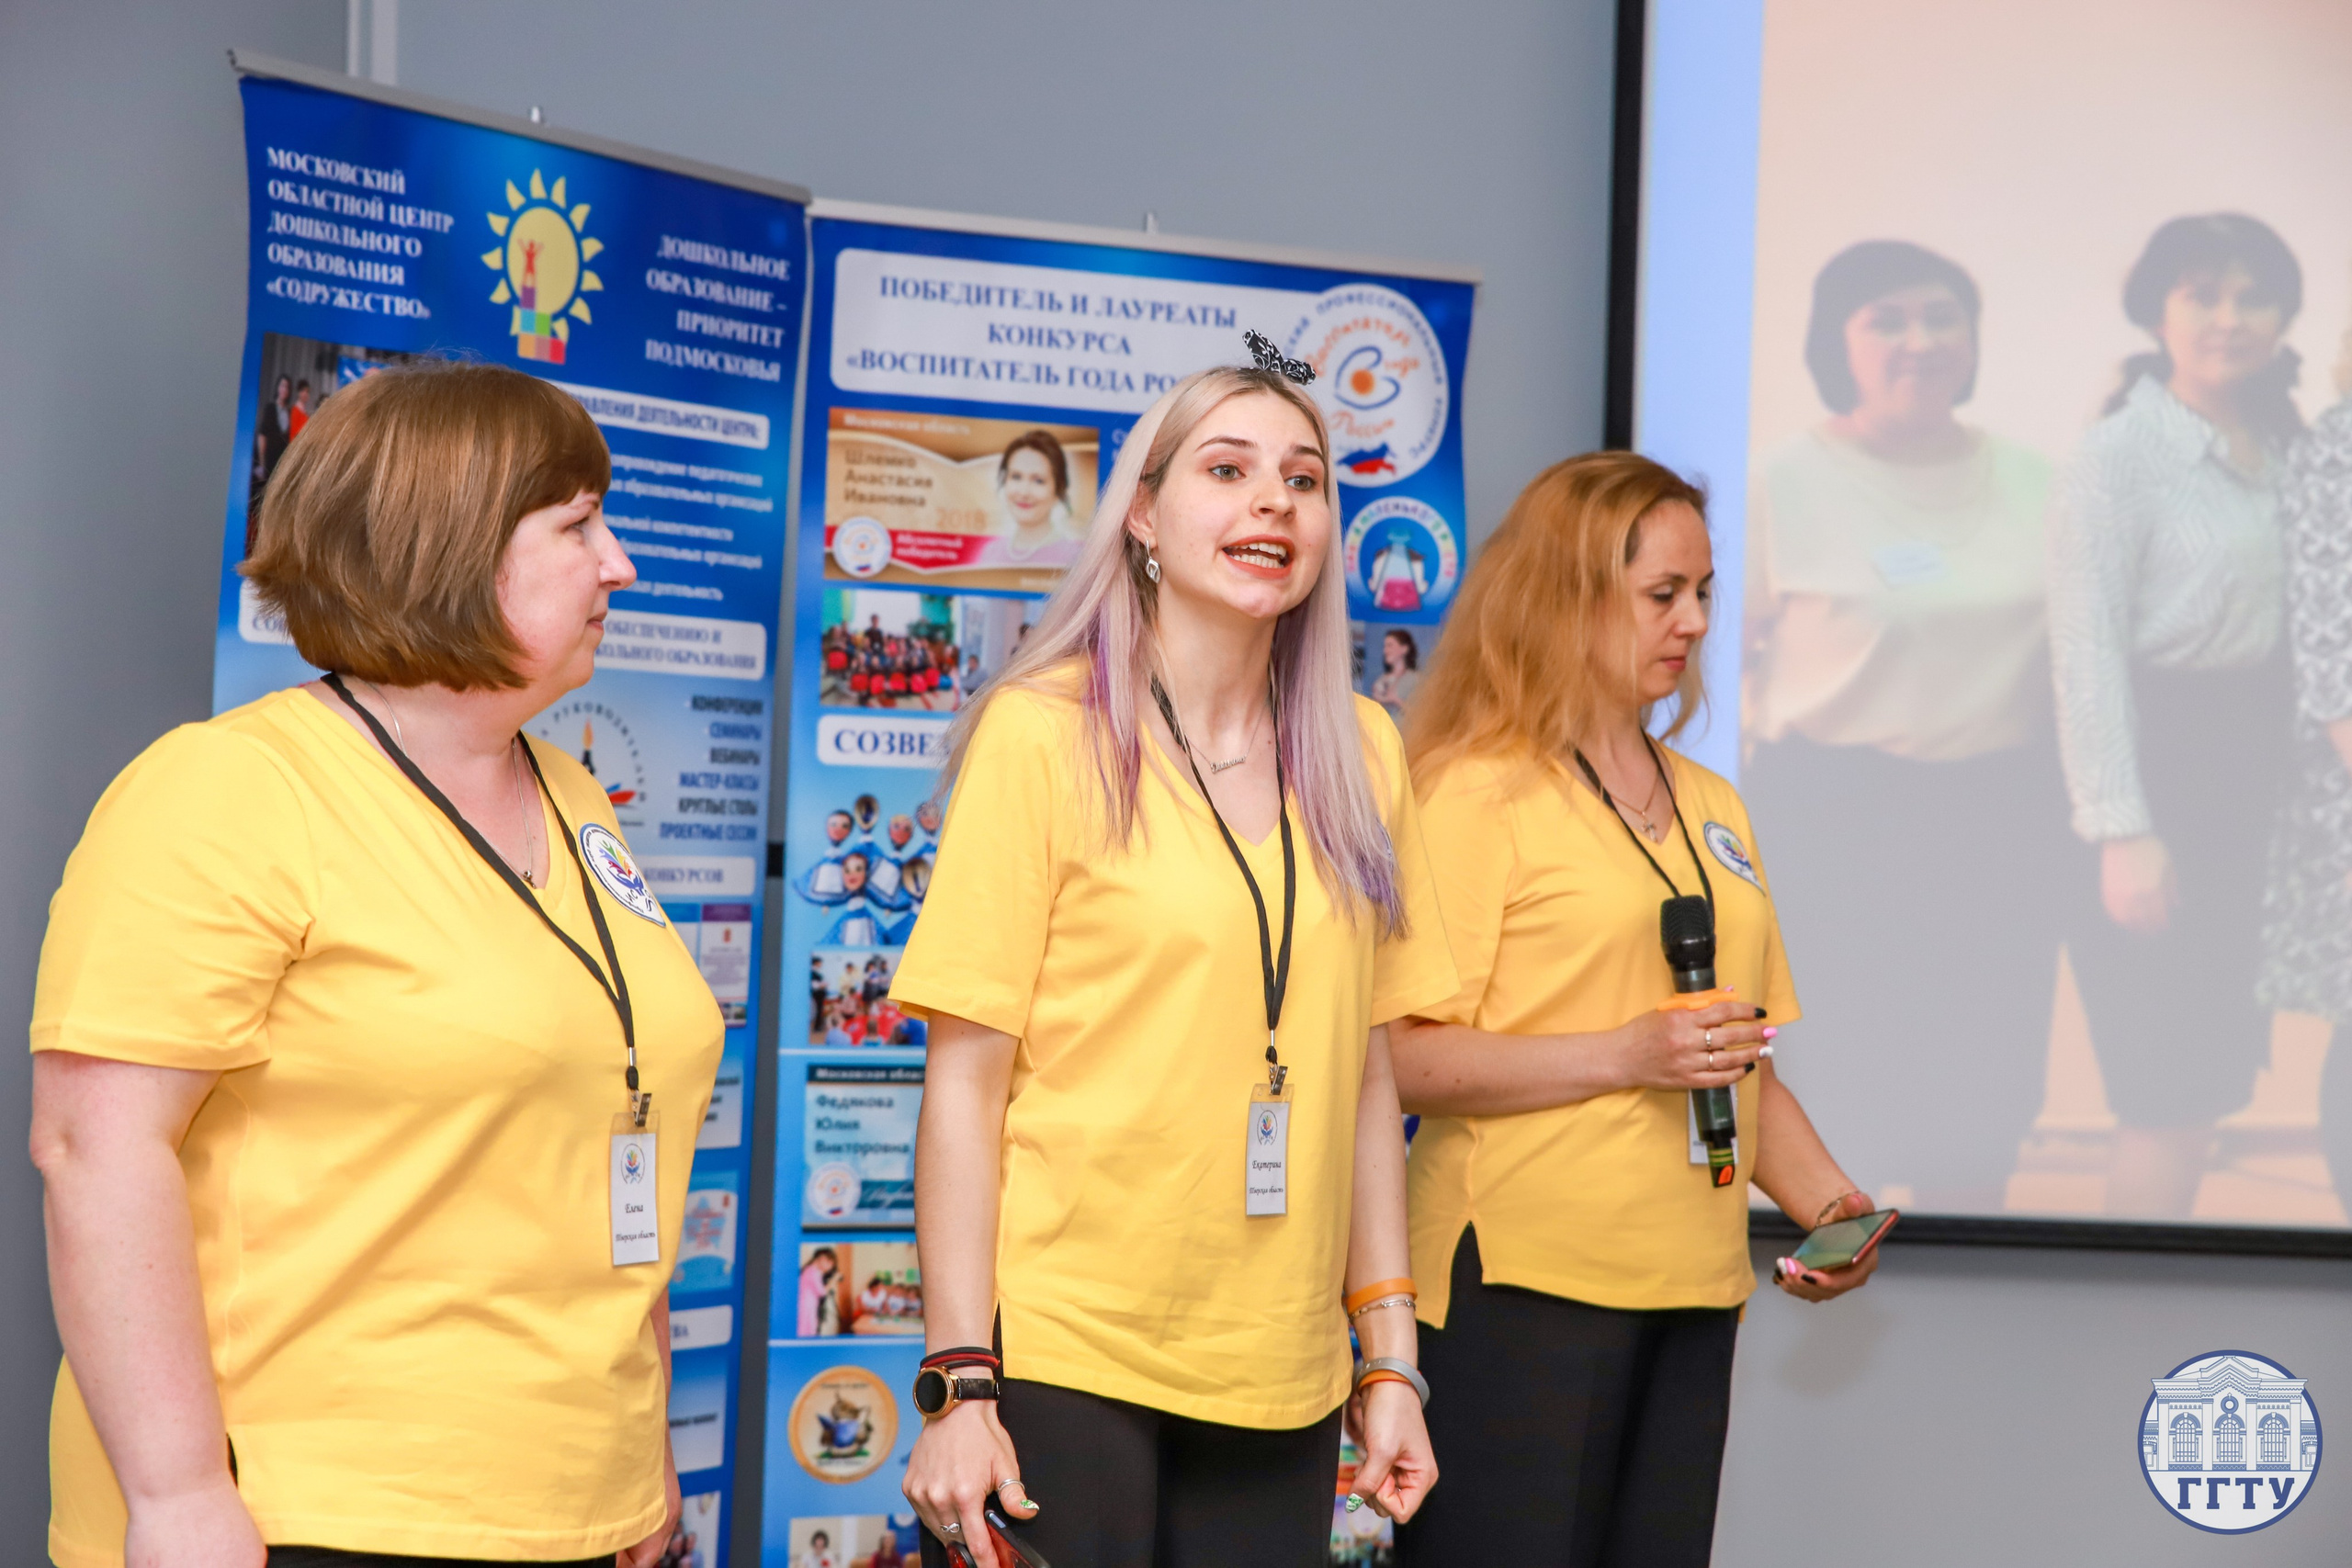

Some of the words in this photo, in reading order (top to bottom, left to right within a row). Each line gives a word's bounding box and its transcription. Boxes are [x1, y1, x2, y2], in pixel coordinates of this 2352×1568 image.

[267, 146, 405, 195] МОСКОВСКИЙ
[268, 179, 384, 221] ОБЛАСТНОЙ
[390, 203, 454, 233] ЦЕНТР
[267, 210, 423, 257] ДОШКОЛЬНОГО
[268, 243, 404, 286] ОБРАЗОВАНИЯ
[656, 234, 790, 281] ДОШКОЛЬНОЕ
[266, 276, 431, 319] «СОДРУЖЕСТВО»
[646, 268, 774, 312] ОБРАЗОВАНИЕ
[880, 276, 1063, 312] ПОБЕДИТЕЛЬ
[1071, 293, 1088, 315] И
[1095, 296, 1237, 328] ЛАУРЕАТЫ
[676, 309, 785, 349] ПРИОРИТЕТ
[988, 322, 1131, 355] КОНКУРСА
[646, 338, 781, 382] ПОДМОСКОВЬЯ
[846, 348, 1059, 385] «ВОСПИТАТЕЛЬ
[1068, 366, 1134, 392] ГОДА
[1143, 373, 1182, 393] РО
[844, 470, 933, 488] Анастасия
[844, 489, 926, 507] Ивановна
[936, 509, 988, 530] 2018
[834, 729, 932, 756] СОЗВЕ
[816, 1094, 893, 1110] Федякова
[816, 1118, 859, 1132] Юлия
[815, 1140, 910, 1156] Викторовна
[1252, 1160, 1282, 1171] Екатерина
[625, 1203, 643, 1213] Елена
